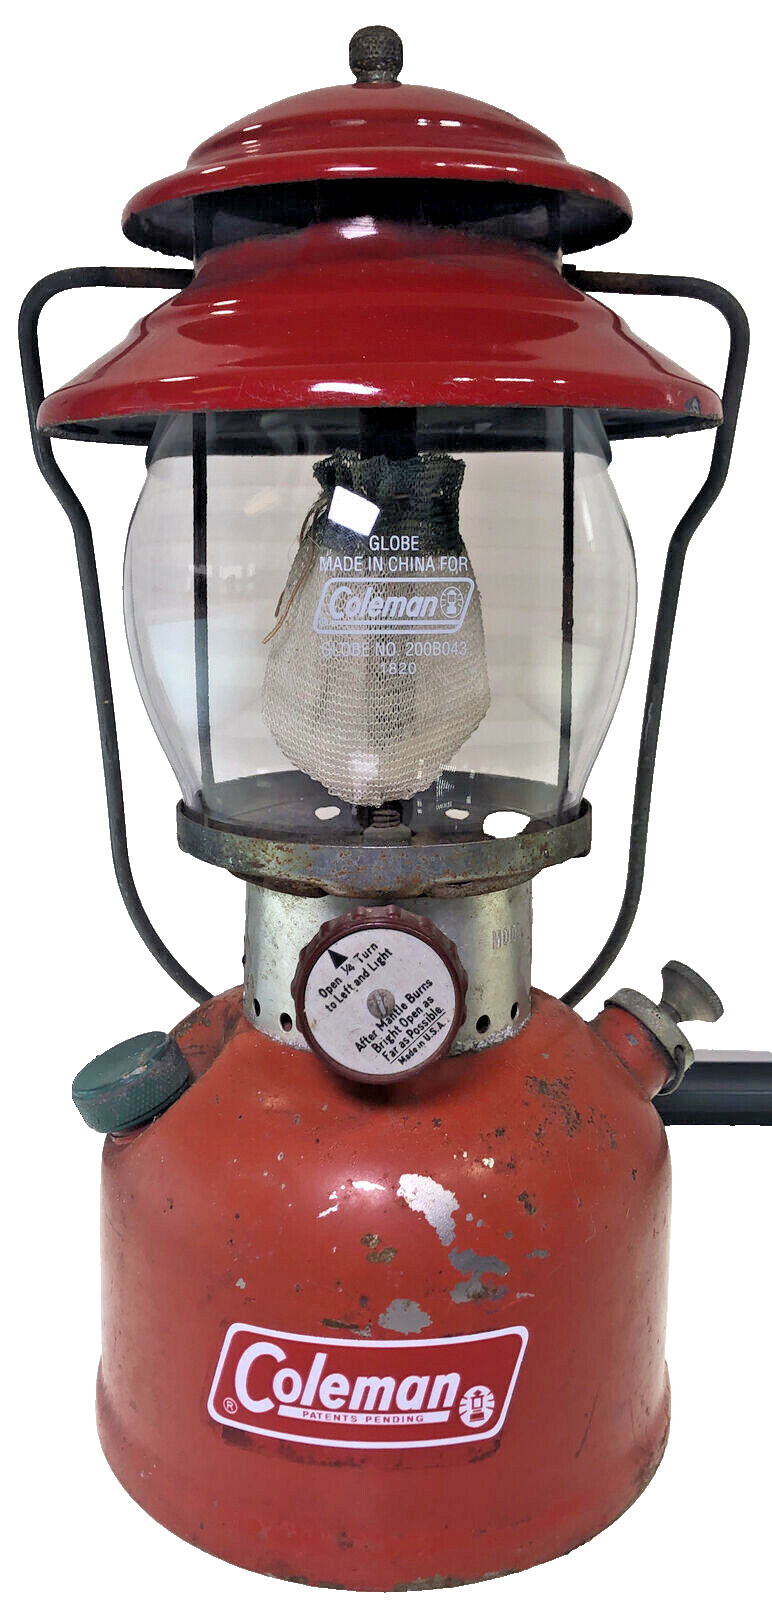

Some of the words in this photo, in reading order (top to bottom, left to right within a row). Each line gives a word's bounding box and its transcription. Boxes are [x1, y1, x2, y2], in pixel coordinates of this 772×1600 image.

[369, 535, 419, 551] GLOBE
[319, 556, 363, 572] MADE
[368, 556, 383, 572] IN
[388, 556, 436, 572] CHINA
[440, 556, 468, 572] FOR
[329, 586, 439, 620] Coleman
[320, 642, 369, 657] GLOBE
[406, 641, 467, 657] 200B043
[380, 662, 417, 675] 1820
[318, 976, 343, 999] Open
[353, 942, 379, 964] Turn
[325, 1001, 337, 1013] to
[334, 984, 355, 1004] Left
[353, 969, 370, 987] and
[368, 947, 393, 972] Light
[354, 1030, 378, 1053] After
[375, 1001, 409, 1032] Mantle
[405, 978, 434, 1004] Burns
[371, 1025, 403, 1054] Bright
[399, 1007, 424, 1029] Open
[422, 995, 435, 1008] as
[382, 1046, 398, 1062] Far
[398, 1036, 411, 1049] as
[407, 1006, 445, 1040] Possible.
[397, 1045, 418, 1066] Made
[416, 1038, 426, 1049] in
[234, 1341, 461, 1414] Coleman
[302, 1409, 358, 1424] PATENTS
[365, 1414, 424, 1424] PENDING
